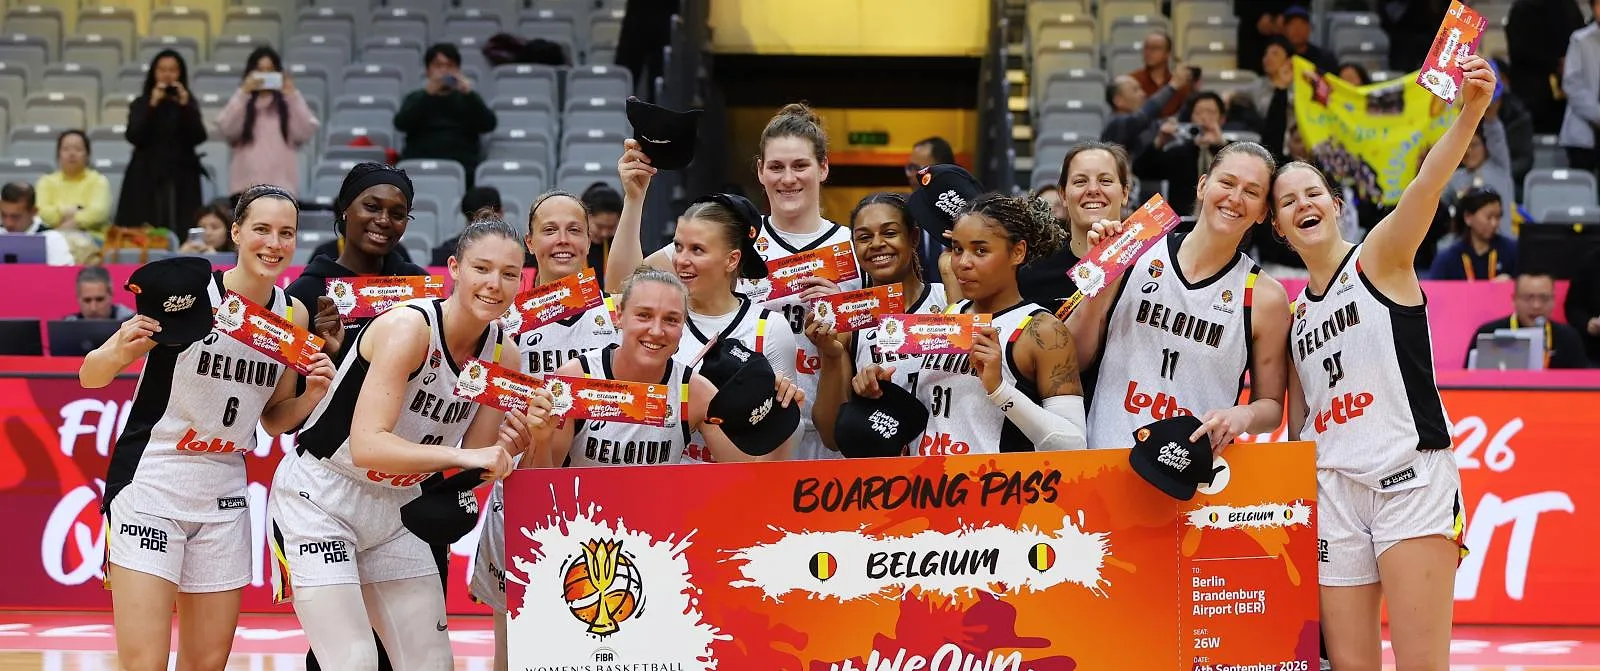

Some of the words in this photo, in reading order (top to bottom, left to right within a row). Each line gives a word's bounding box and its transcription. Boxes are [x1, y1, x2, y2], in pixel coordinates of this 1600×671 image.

[782, 304, 805, 334] 13
[1136, 299, 1225, 349] BELGIUM
[1297, 300, 1361, 362] BELGIUM
[197, 350, 279, 388] BELGIUM
[1160, 348, 1180, 381] 11
[931, 385, 952, 418] 31
[222, 397, 240, 427] 6
[585, 437, 672, 465] BELGIUM
[793, 473, 970, 513] BOARDING
[980, 469, 1063, 506] PASS
[1228, 511, 1274, 523] BELGIUM
[120, 524, 168, 541] POWER
[140, 538, 168, 553] ADE
[299, 540, 346, 556] POWER
[324, 551, 350, 564] ADE
[866, 548, 999, 579] BELGIUM
[1192, 575, 1225, 587] Berlin
[1192, 589, 1266, 602] Brandenburg
[1192, 603, 1232, 617] Airport
[1234, 600, 1266, 615] (BER)
[1194, 637, 1220, 649] 26W
[595, 653, 614, 662] FIBA
[1215, 662, 1276, 671] September
[1279, 660, 1308, 671] 2026
[596, 662, 684, 671] BASKETBALL
